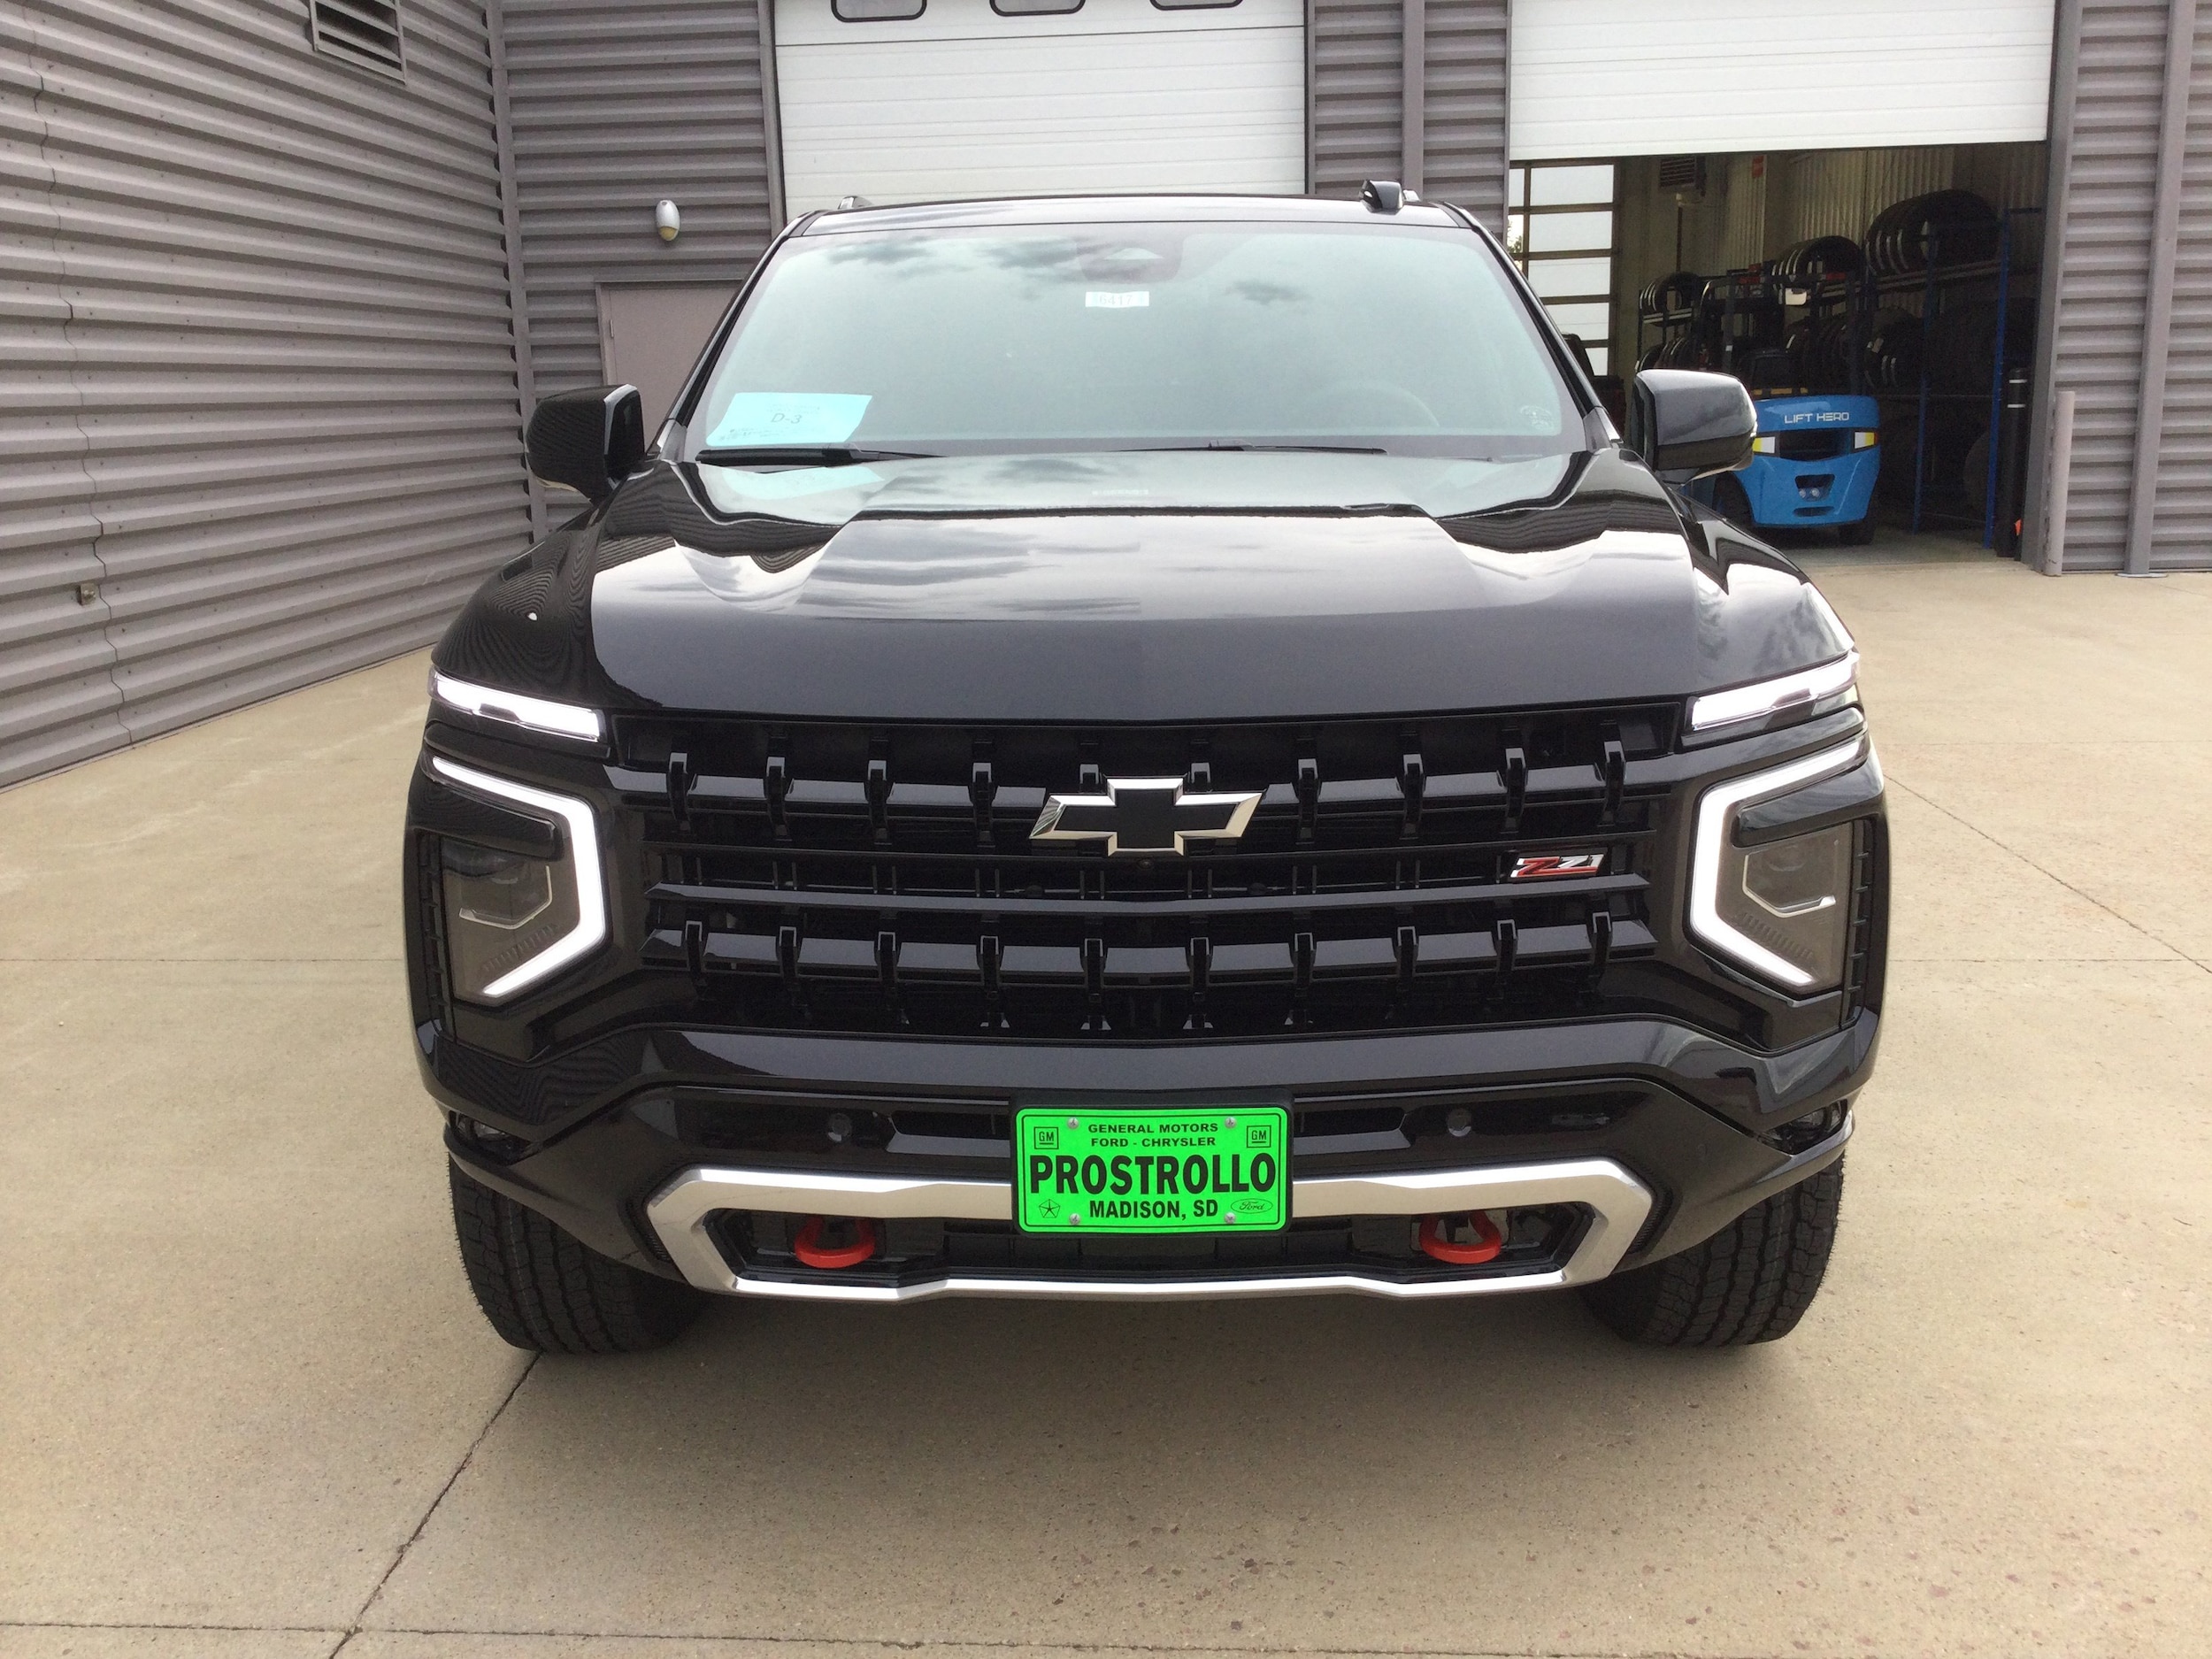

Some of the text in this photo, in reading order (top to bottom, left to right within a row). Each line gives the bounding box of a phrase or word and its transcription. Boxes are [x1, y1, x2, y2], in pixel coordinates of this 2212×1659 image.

[1784, 411, 1849, 424] LIFT HERO
[1510, 854, 1604, 878] Z71
[1087, 1123, 1218, 1133] GENERAL MOTORS
[1038, 1131, 1054, 1142] GM
[1251, 1129, 1267, 1141] GM
[1090, 1138, 1129, 1148] FORD
[1141, 1136, 1216, 1147] CHRYSLER
[1030, 1153, 1276, 1194] PROSTROLLO
[1089, 1199, 1218, 1221] MADISON, SD
